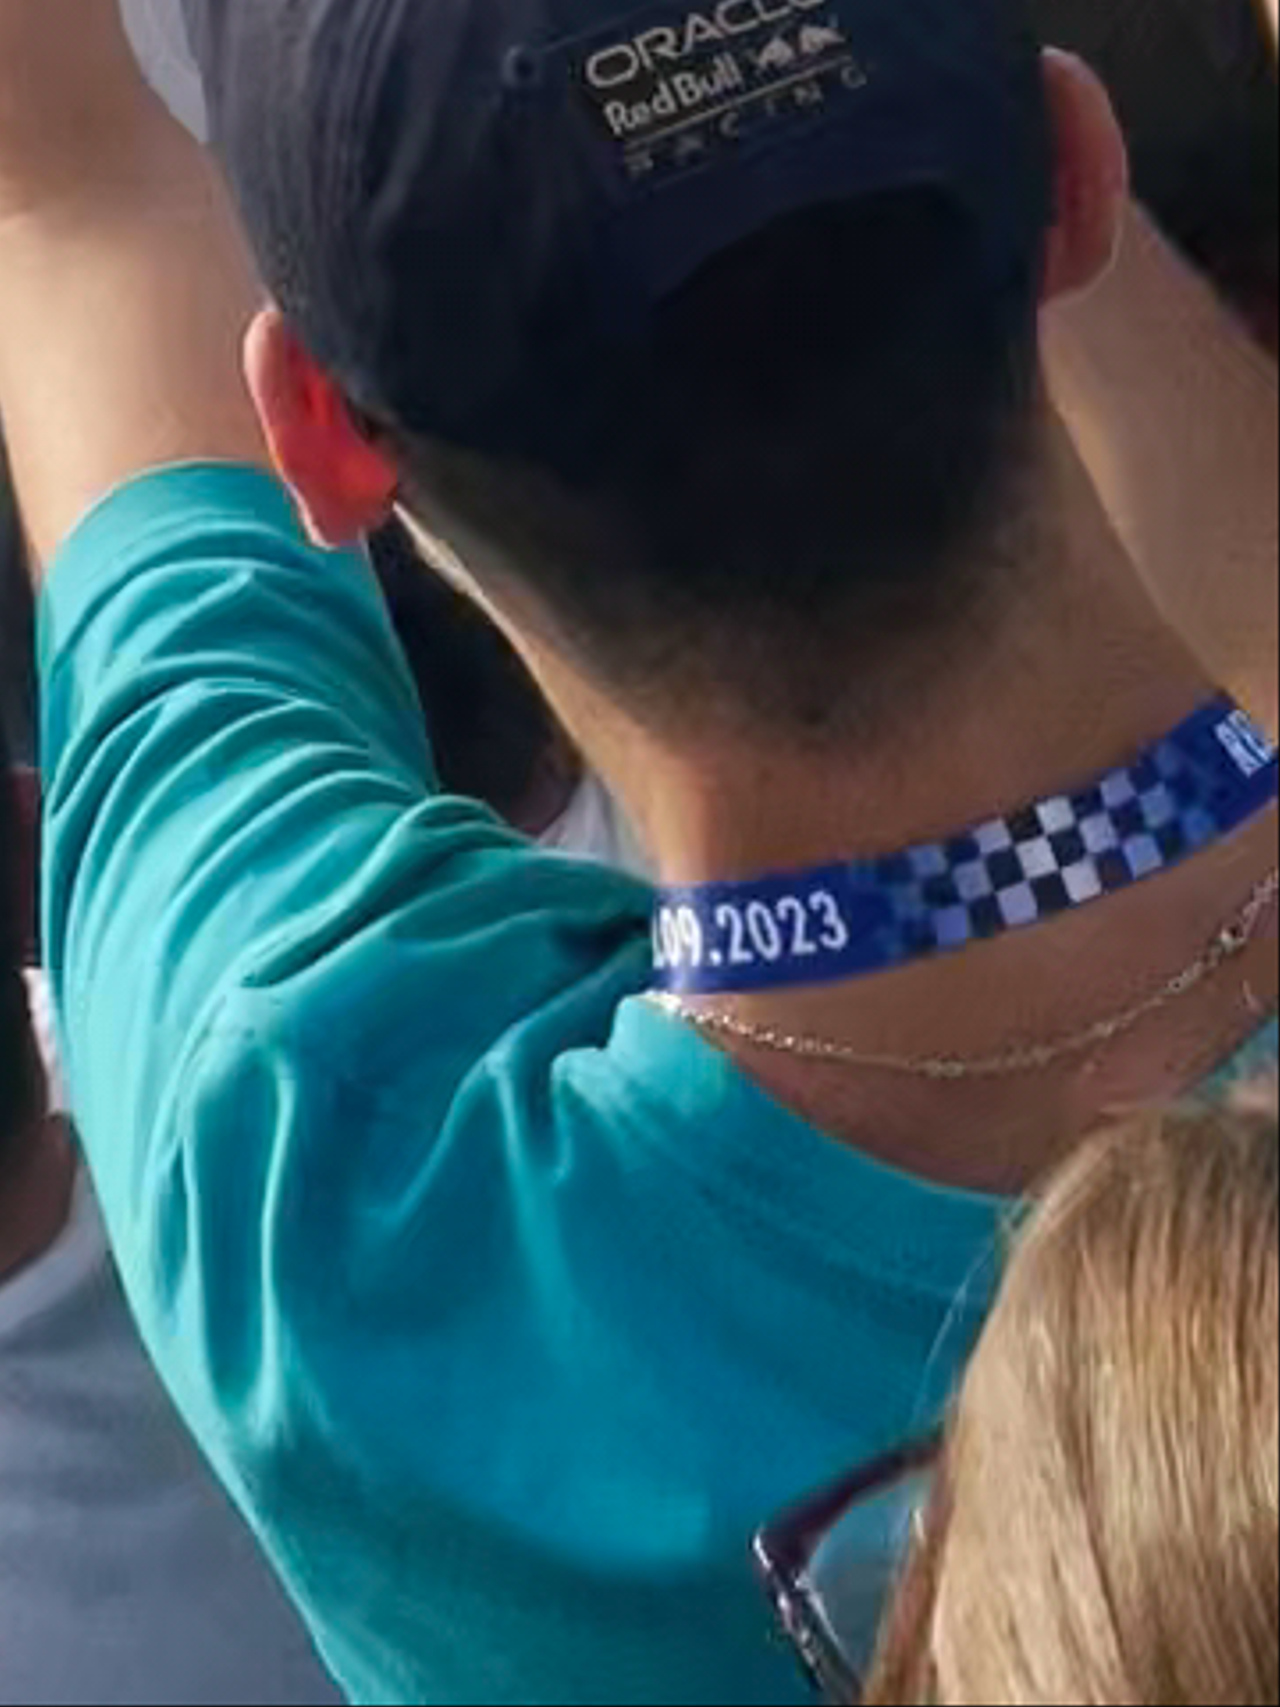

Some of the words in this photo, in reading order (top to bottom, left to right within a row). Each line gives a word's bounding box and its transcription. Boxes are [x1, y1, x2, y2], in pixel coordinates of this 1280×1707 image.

[603, 80, 678, 135] Red
[673, 52, 743, 106] Bull
[651, 890, 849, 970] .09.2023
